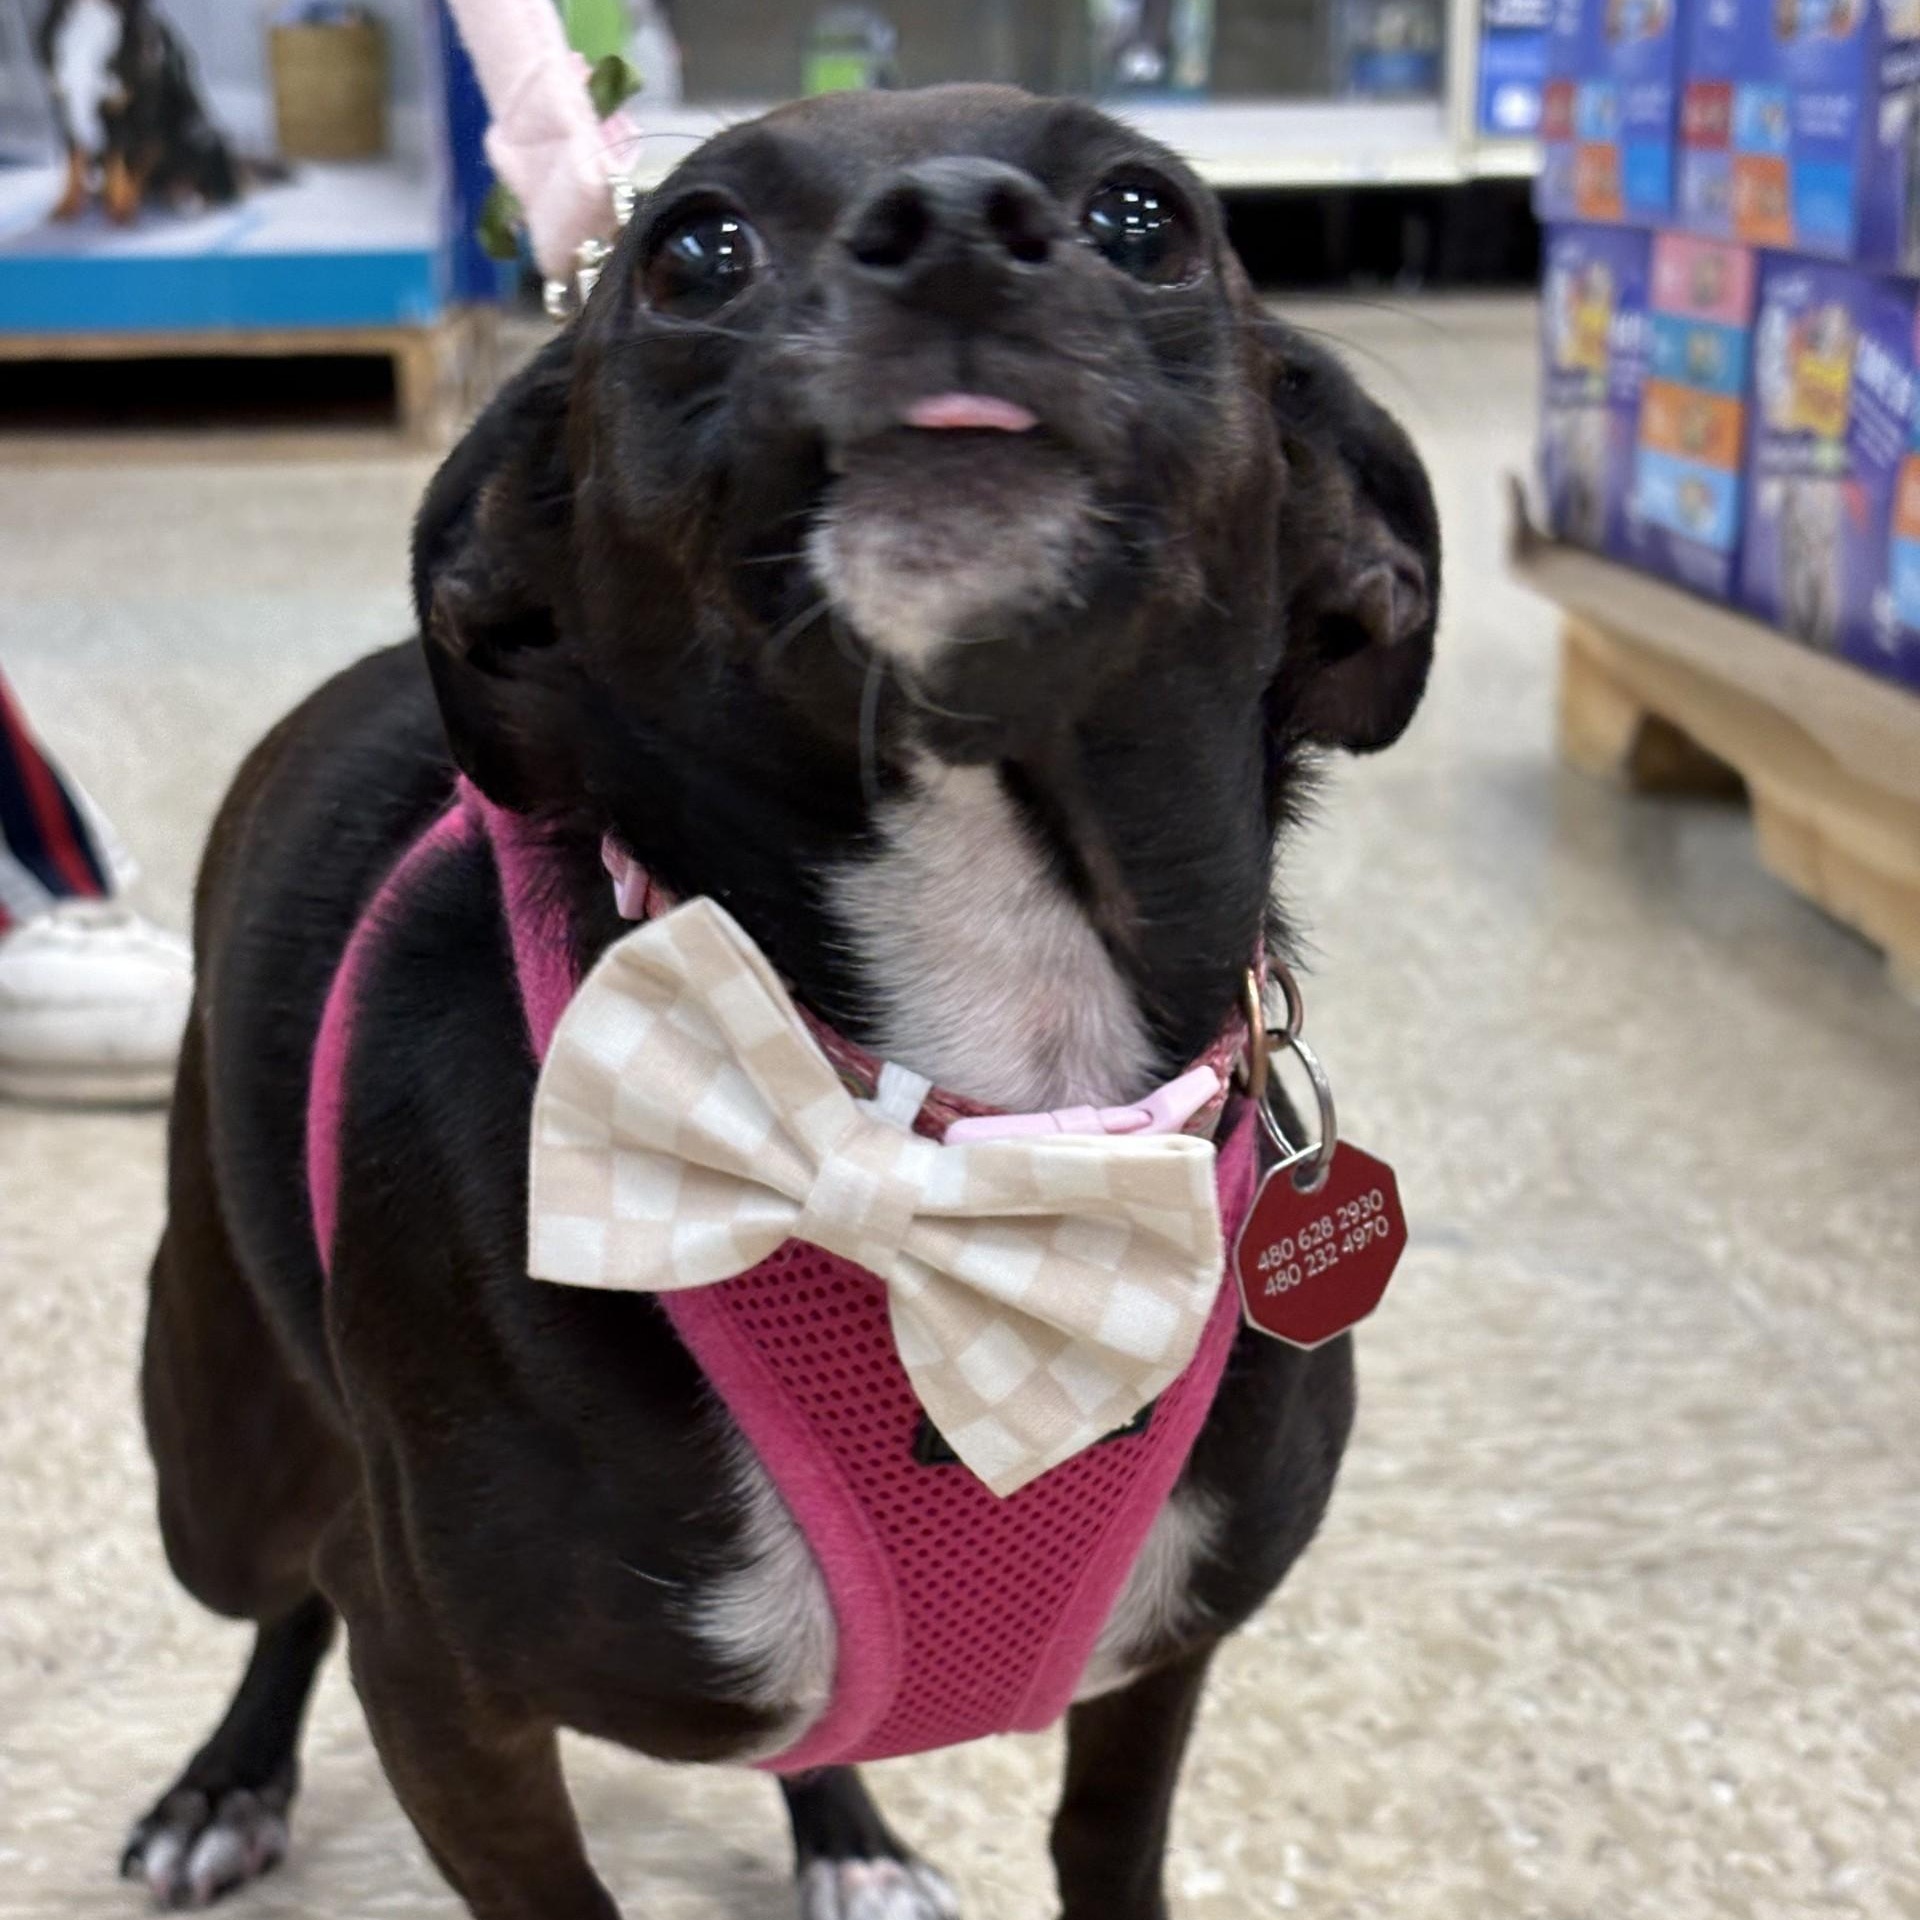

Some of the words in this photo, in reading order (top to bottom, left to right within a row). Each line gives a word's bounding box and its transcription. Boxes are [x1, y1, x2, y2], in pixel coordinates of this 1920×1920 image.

[1257, 1238, 1294, 1271] 480
[1298, 1215, 1334, 1250] 628
[1336, 1188, 1384, 1231] 2930
[1264, 1263, 1301, 1297] 480
[1304, 1243, 1339, 1277] 232
[1341, 1215, 1389, 1254] 4970
